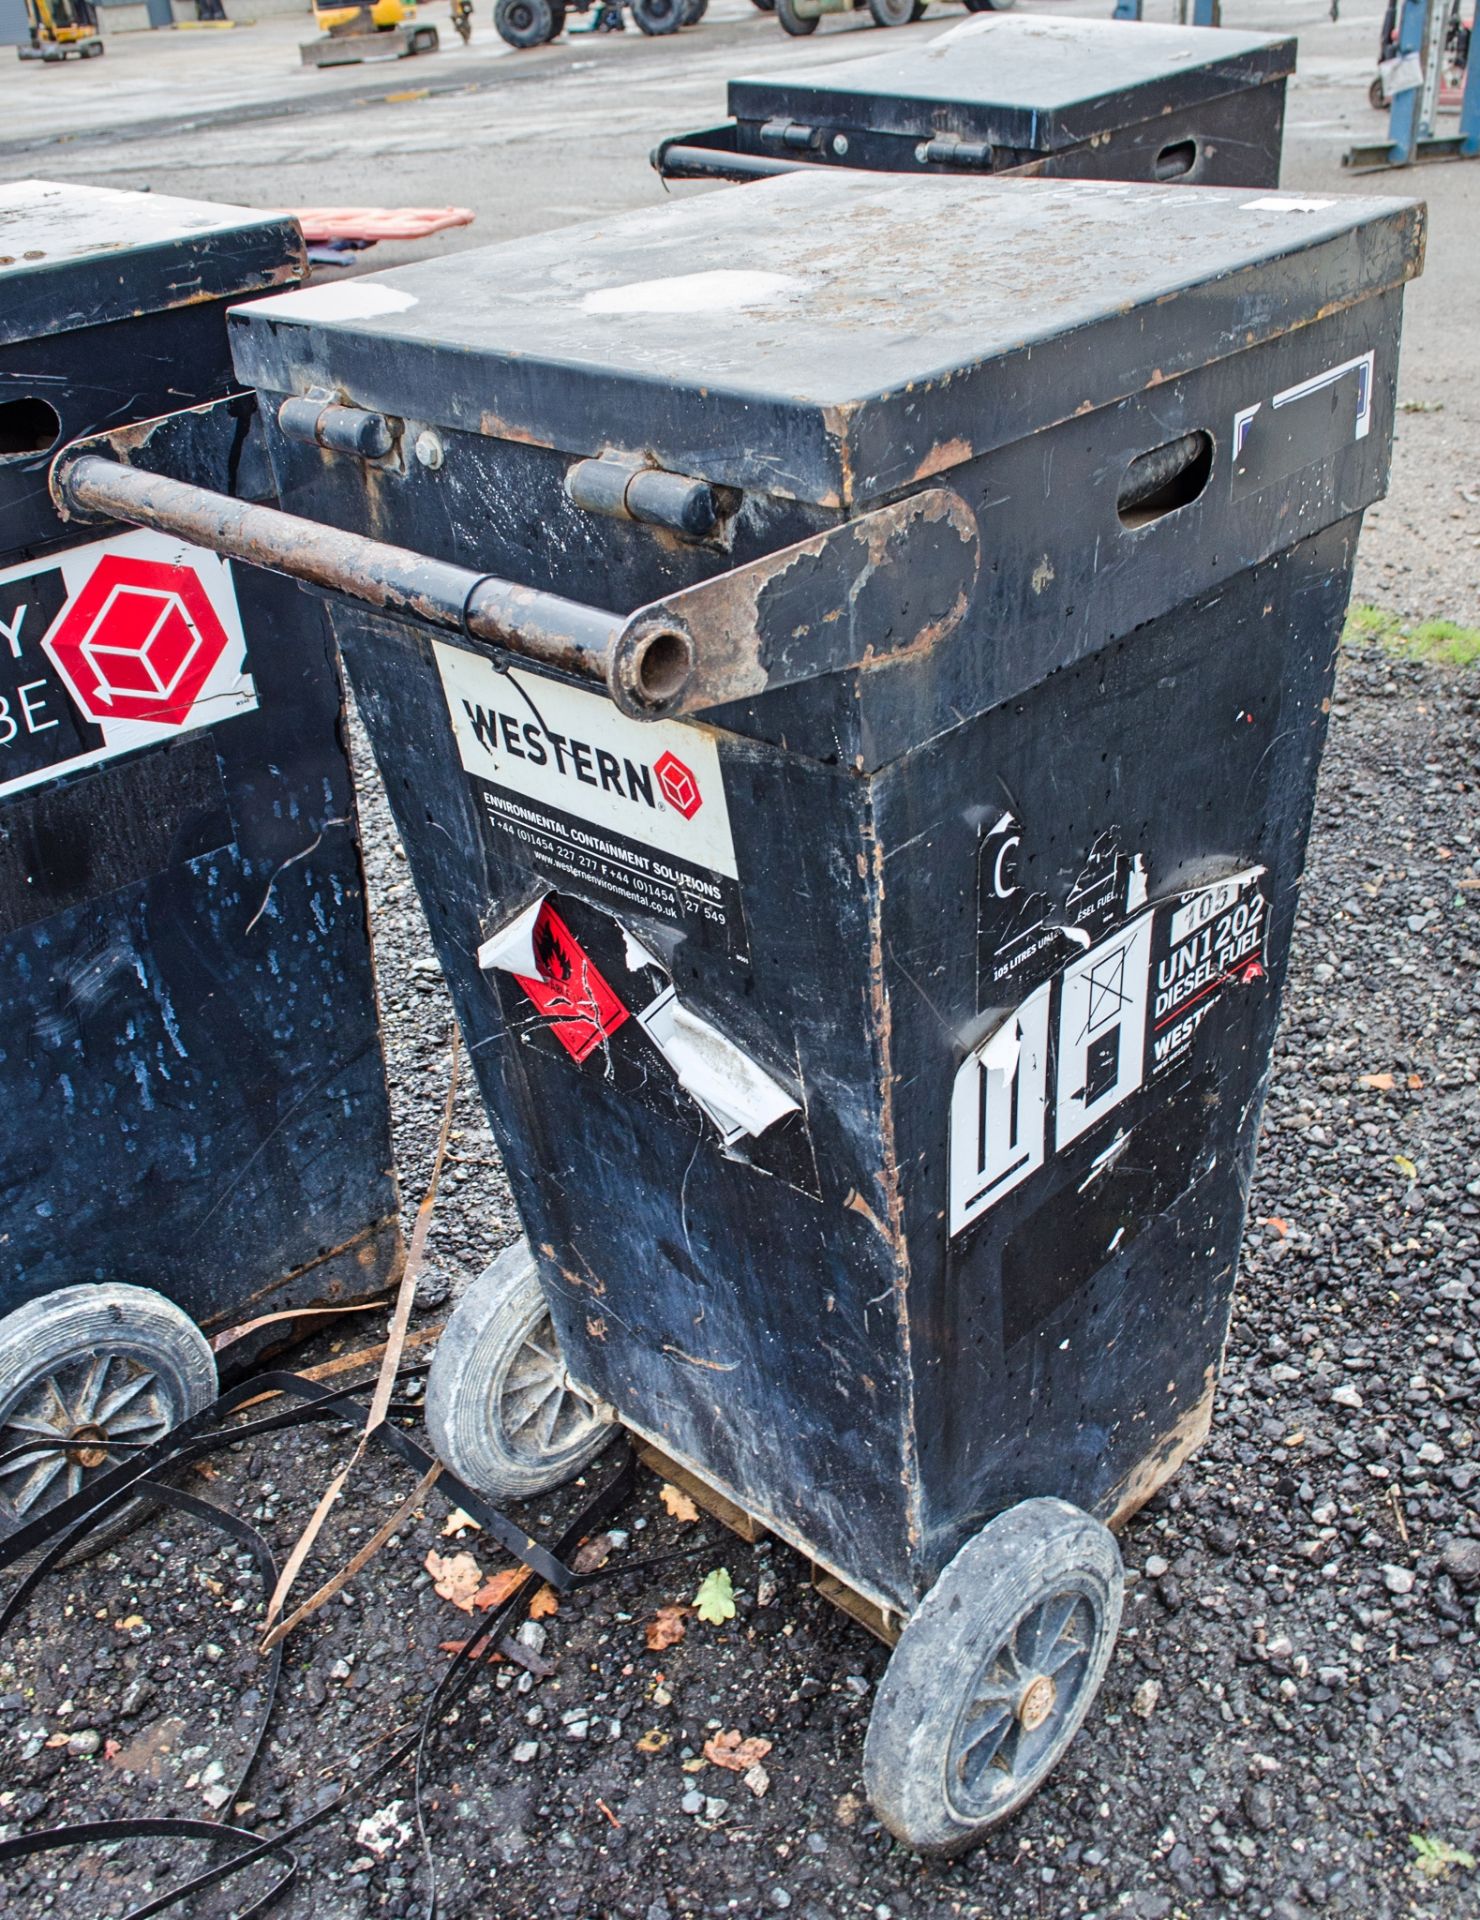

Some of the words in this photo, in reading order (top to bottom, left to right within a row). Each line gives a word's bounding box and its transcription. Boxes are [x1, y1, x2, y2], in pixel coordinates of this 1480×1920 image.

[462, 699, 656, 809] WESTERN
[483, 792, 569, 837] ENVIRONMENTAL
[570, 828, 650, 870] CONTAINMENT
[652, 861, 722, 900] SOLUTIONS
[489, 816, 495, 827] T
[497, 821, 515, 835] +44
[517, 828, 554, 852] (0)1454
[557, 846, 575, 861] 227
[578, 855, 598, 871] 277
[601, 864, 608, 875] F
[610, 870, 630, 885] +44
[632, 878, 675, 904] (0)1454
[704, 907, 726, 925] 549
[534, 851, 678, 919] www.westernenvironmental.co.uk
[993, 963, 1009, 982] 105
[1009, 943, 1037, 970] LITRES
[1097, 891, 1115, 909] FUEL
[1154, 959, 1217, 1019] DIESEL
[1219, 927, 1262, 971] FUEL
[1158, 893, 1265, 990] UN1202
